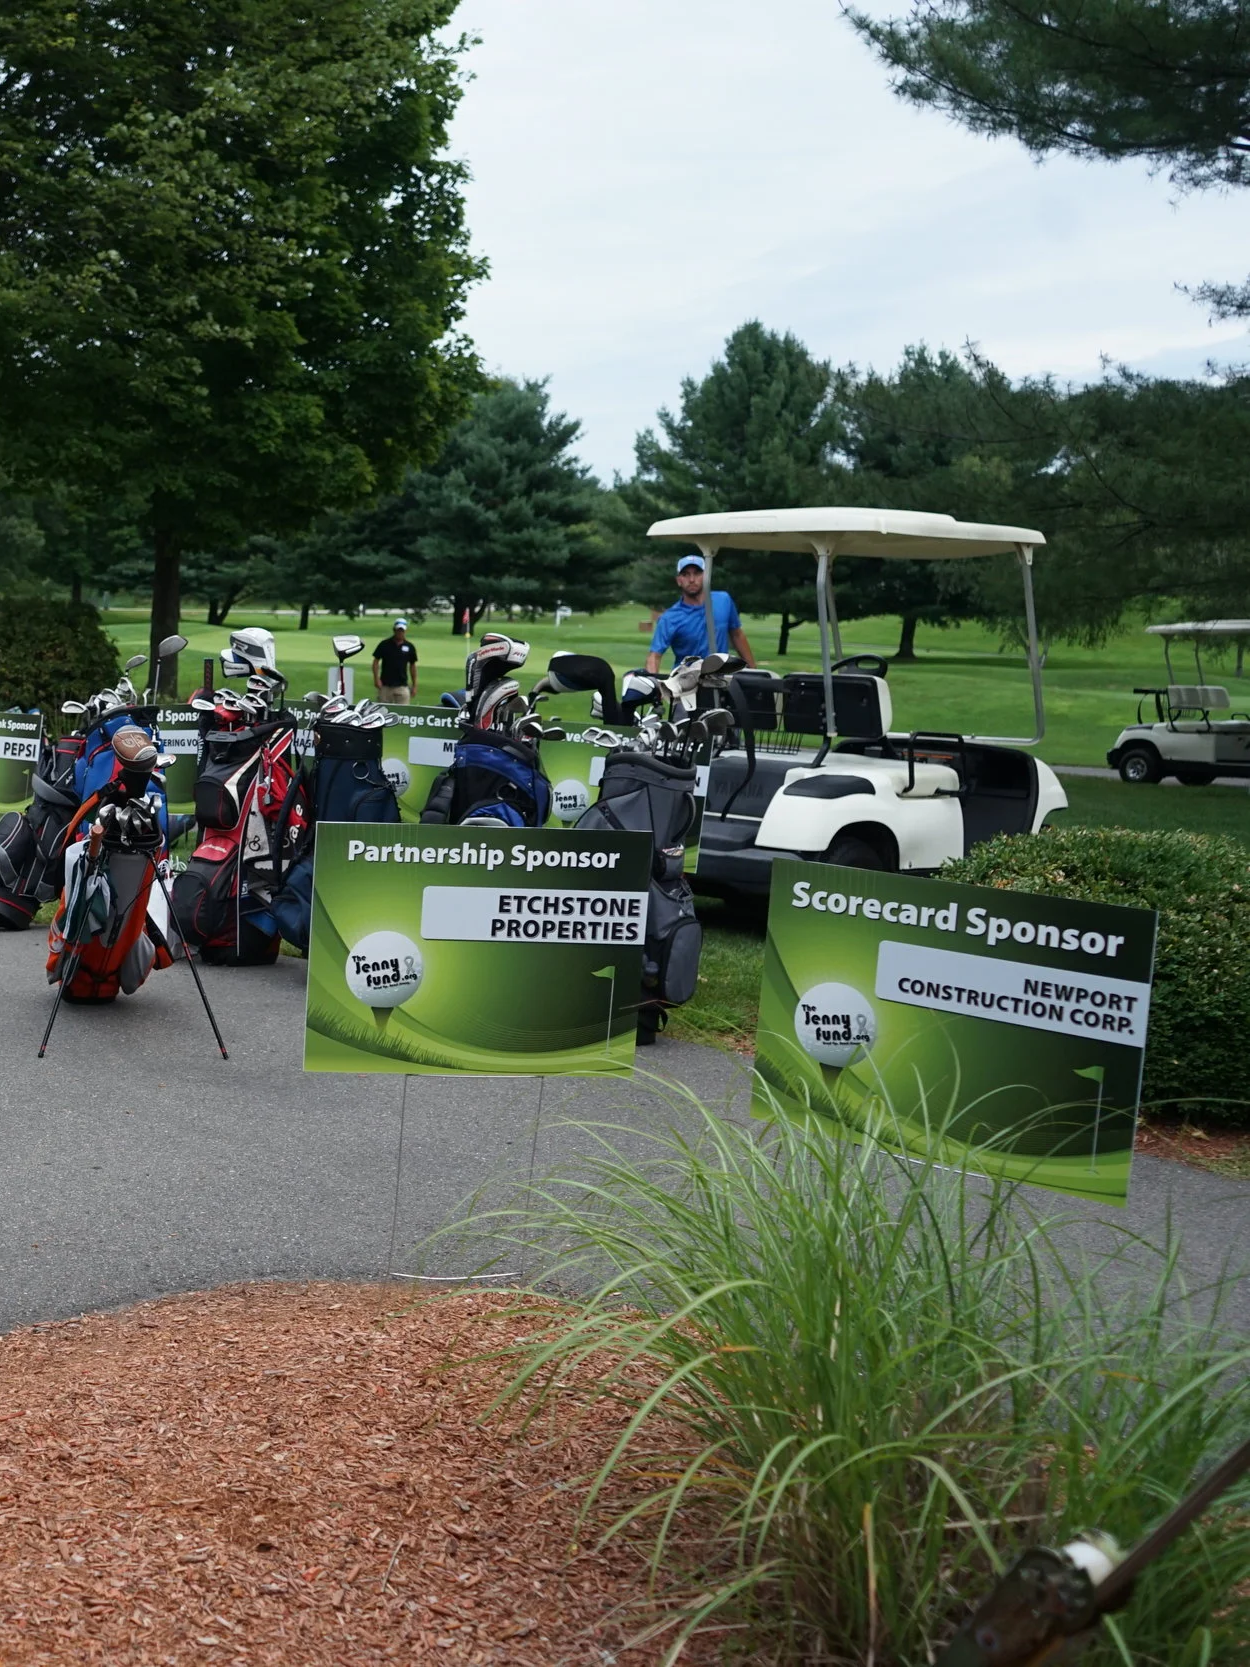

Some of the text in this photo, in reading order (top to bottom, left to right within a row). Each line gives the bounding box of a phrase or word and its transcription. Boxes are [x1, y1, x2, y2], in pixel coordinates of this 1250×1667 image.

[7, 719, 37, 731] Sponsor
[427, 714, 452, 728] Cart
[4, 742, 36, 758] PEPSI
[348, 839, 621, 872] Partnership Sponsor
[498, 894, 641, 917] ETCHSTONE
[491, 918, 639, 941] PROPERTIES
[790, 880, 1125, 957] Scorecard Sponsor
[355, 958, 399, 975] Jenny
[898, 976, 1135, 1036] CONSTRUCTION CORP.
[1023, 978, 1138, 1013] NEWPORT
[805, 1011, 851, 1029] Jenny
